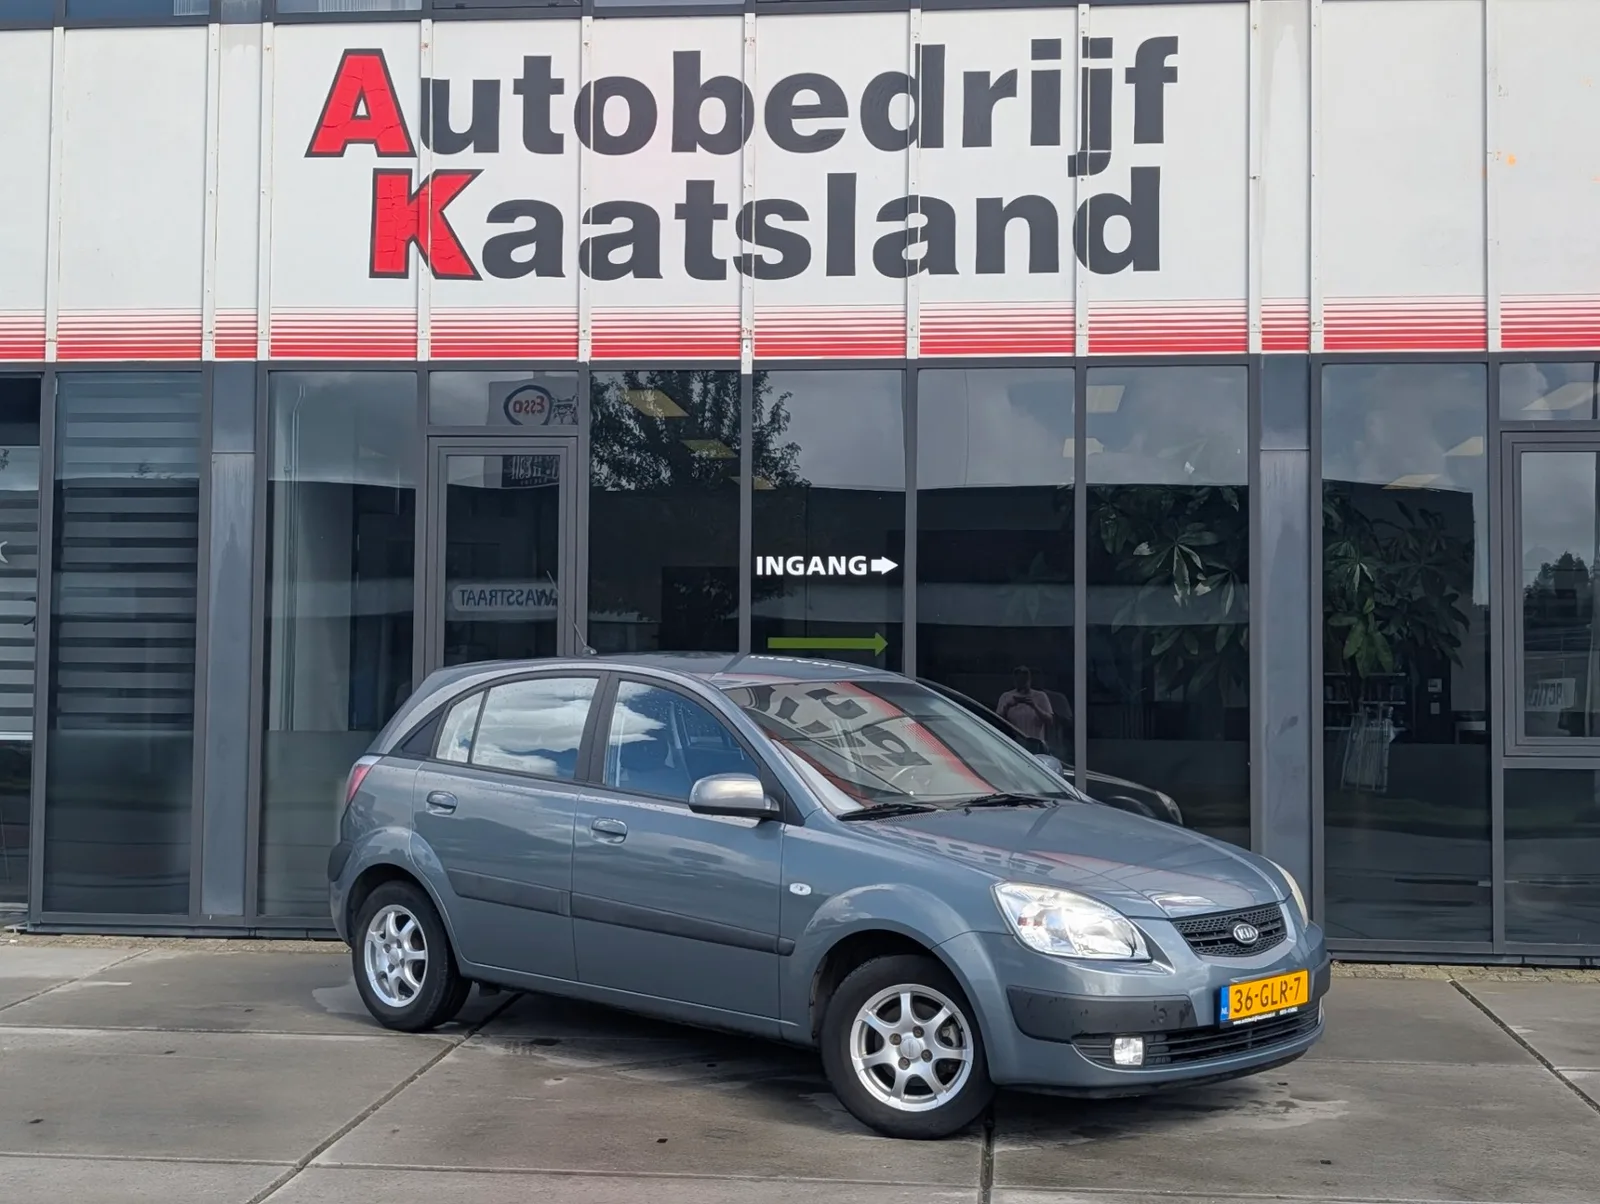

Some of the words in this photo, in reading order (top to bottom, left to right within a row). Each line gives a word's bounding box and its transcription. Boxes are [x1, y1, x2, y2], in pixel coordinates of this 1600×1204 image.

[304, 37, 1178, 178] Autobedrijf
[369, 166, 1162, 280] Kaatsland
[756, 555, 868, 576] INGANG
[1236, 927, 1256, 940] KIA
[1233, 976, 1302, 1014] 36-GLR-7
